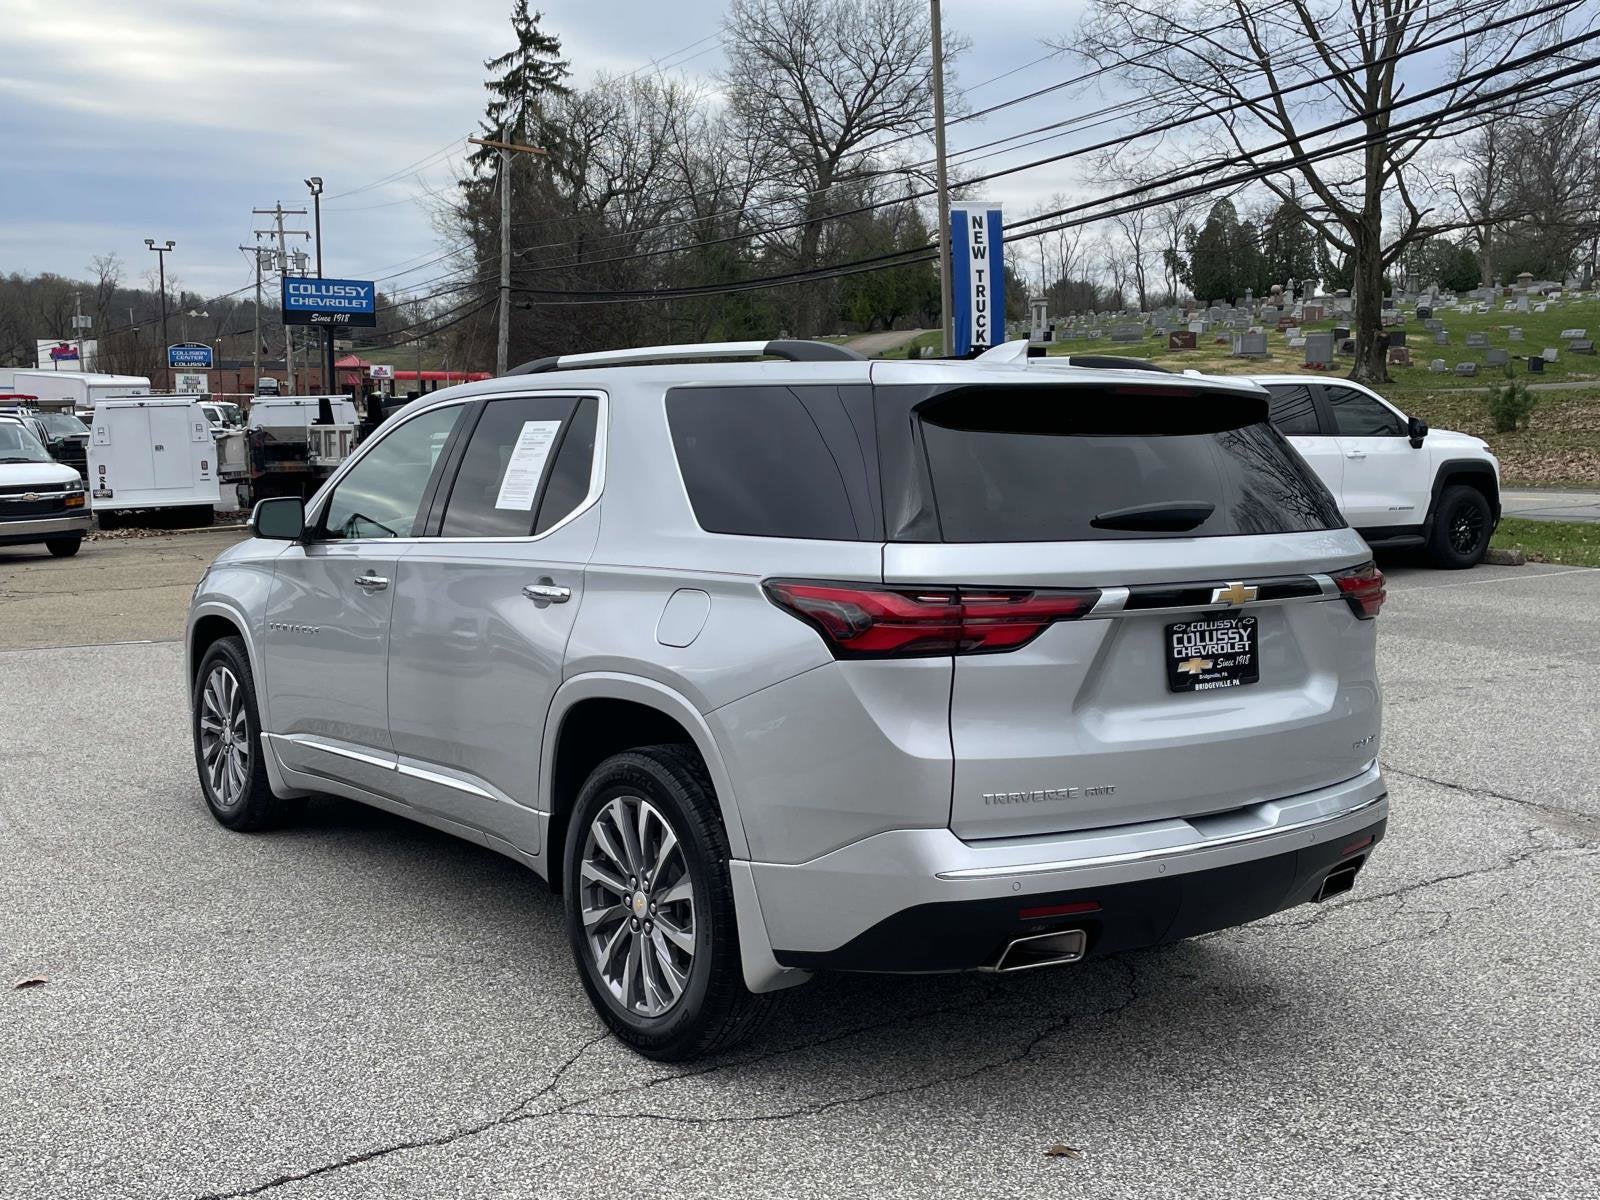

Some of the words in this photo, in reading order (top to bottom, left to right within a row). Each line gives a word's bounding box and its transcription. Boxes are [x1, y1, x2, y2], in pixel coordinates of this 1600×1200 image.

[972, 216, 986, 260] NEW
[289, 283, 368, 297] COLUSSY
[290, 296, 369, 308] CHEVROLET
[975, 270, 986, 343] TRUCK
[310, 313, 331, 322] Since
[333, 313, 350, 322] 1918
[1190, 619, 1238, 631] COLUSSY
[1173, 627, 1252, 648] COLUSSY
[1173, 641, 1252, 658] CHEVROLET
[1216, 657, 1234, 668] Since
[1235, 654, 1251, 666] 1918
[1232, 678, 1240, 686] PA
[982, 787, 1079, 806] TRAVERSE
